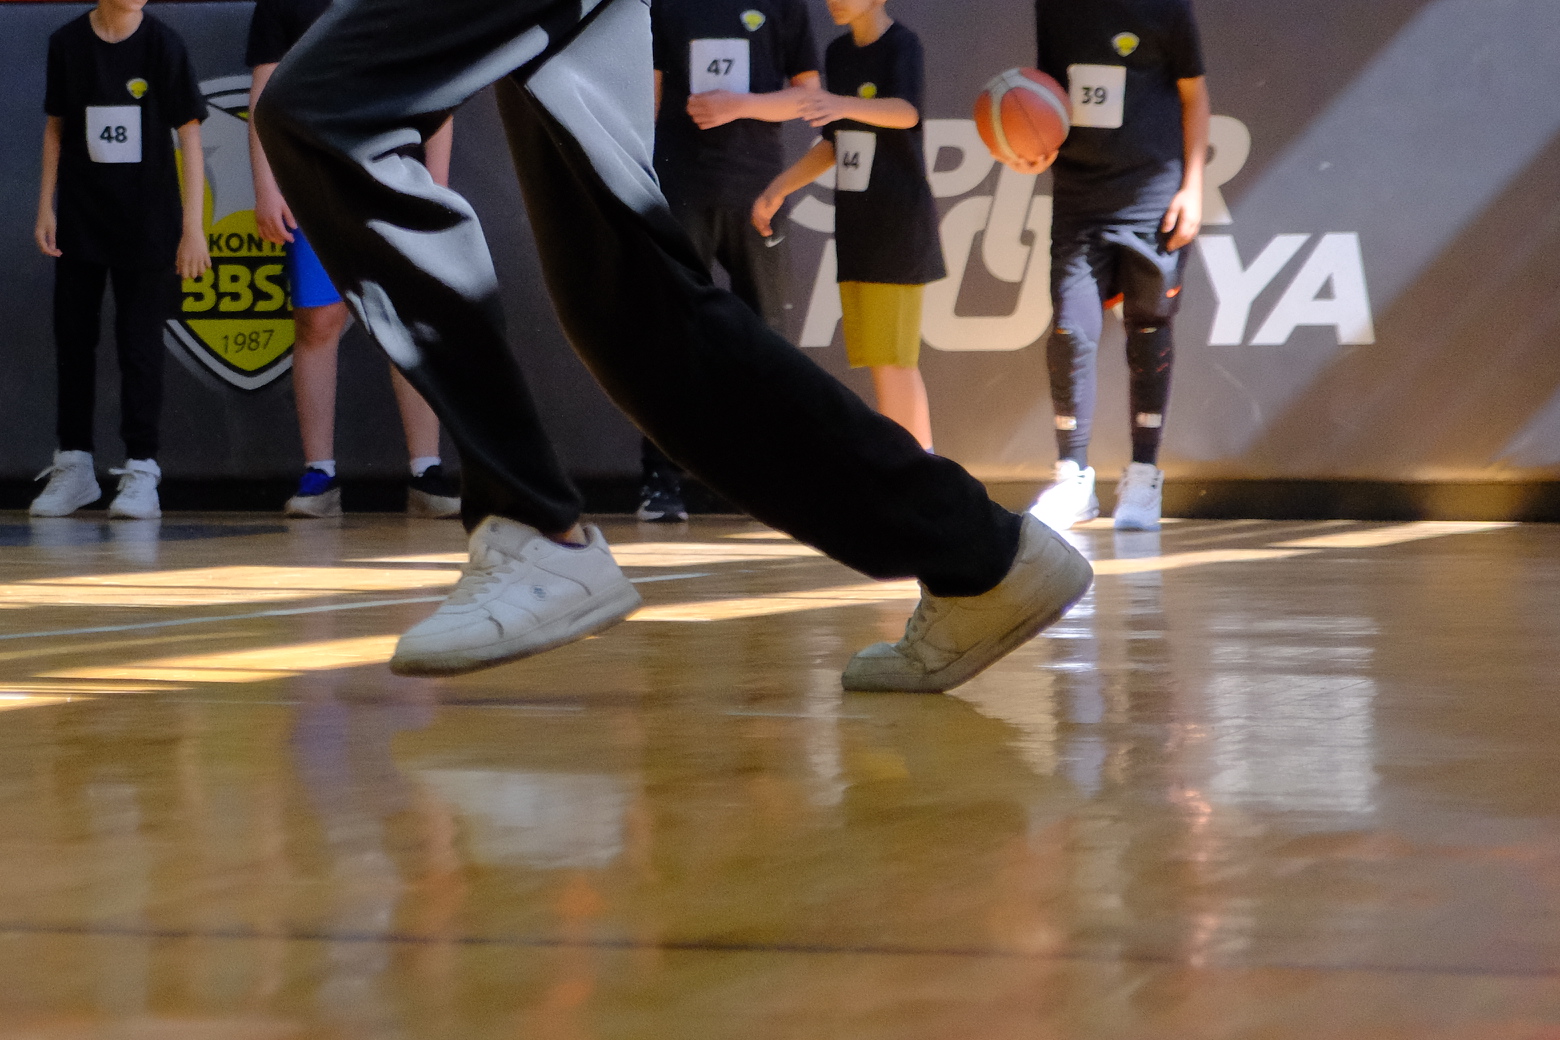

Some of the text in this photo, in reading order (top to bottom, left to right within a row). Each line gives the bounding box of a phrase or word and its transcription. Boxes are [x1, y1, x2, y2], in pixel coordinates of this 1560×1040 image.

[706, 59, 735, 77] 47
[1081, 86, 1107, 105] 39
[100, 125, 128, 144] 48
[843, 151, 860, 170] 44
[181, 264, 294, 312] BBS
[222, 329, 275, 354] 1987
